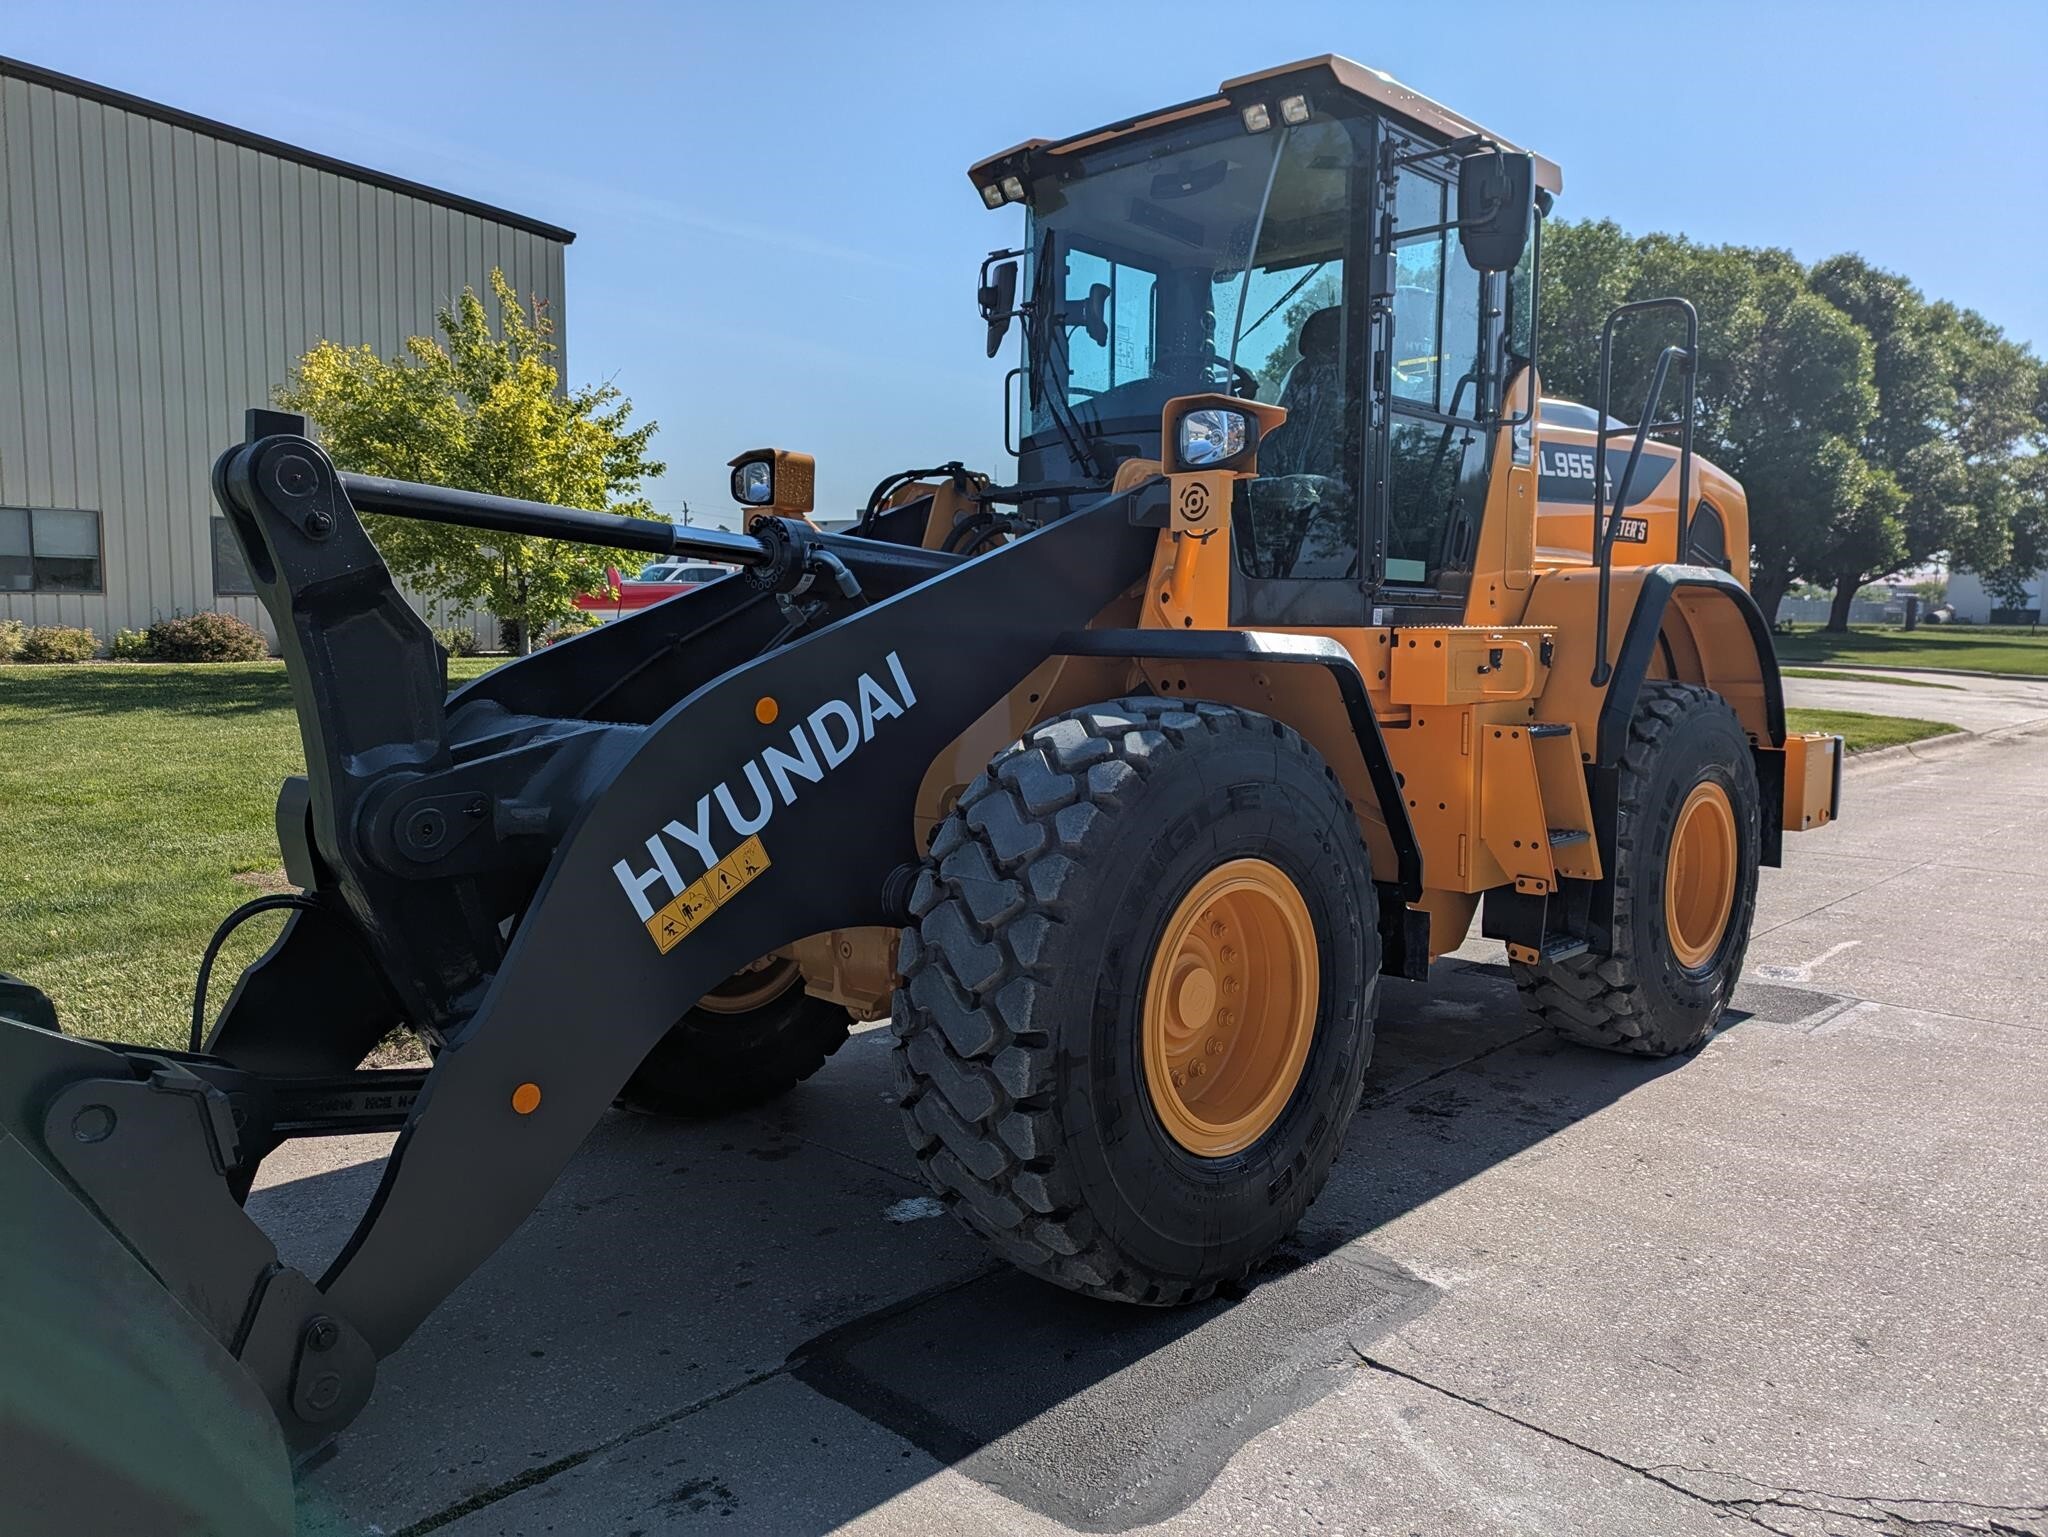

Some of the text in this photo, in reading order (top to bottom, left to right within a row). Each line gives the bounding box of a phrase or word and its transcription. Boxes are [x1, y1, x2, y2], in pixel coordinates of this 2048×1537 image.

[1538, 451, 1612, 481] L955
[1602, 517, 1647, 540] RTER'S
[612, 650, 918, 922] HYUNDAI
